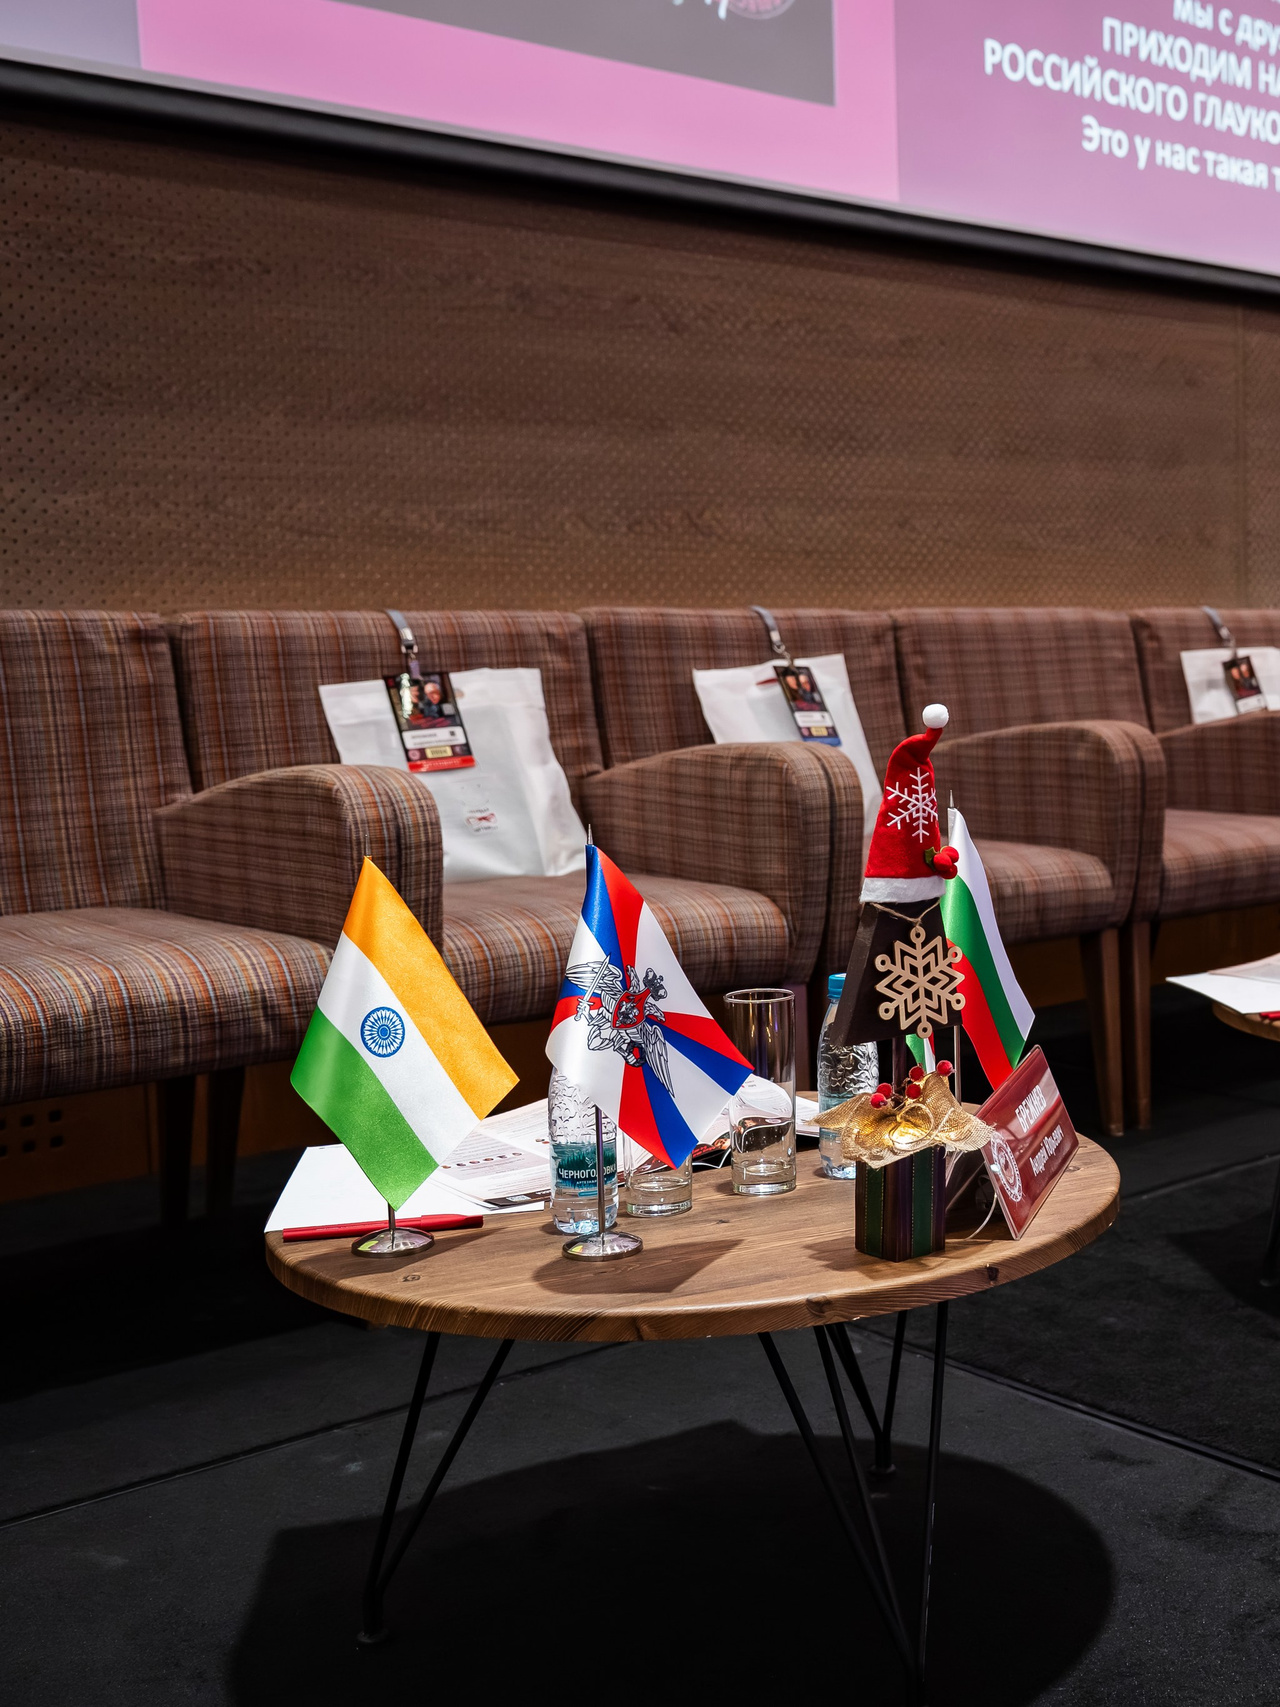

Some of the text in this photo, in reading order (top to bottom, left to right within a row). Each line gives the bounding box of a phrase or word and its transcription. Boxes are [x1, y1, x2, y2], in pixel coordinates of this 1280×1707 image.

[1102, 17, 1252, 90] ПРИХОДИМ
[1218, 8, 1235, 37] с
[984, 38, 1188, 121] РОССИЙСКОГО
[1081, 115, 1129, 158] Это
[1134, 135, 1151, 170] у
[1155, 139, 1200, 174] нас
[1202, 150, 1269, 190] такая
[1015, 1085, 1047, 1133] БРЕЖНЕВ
